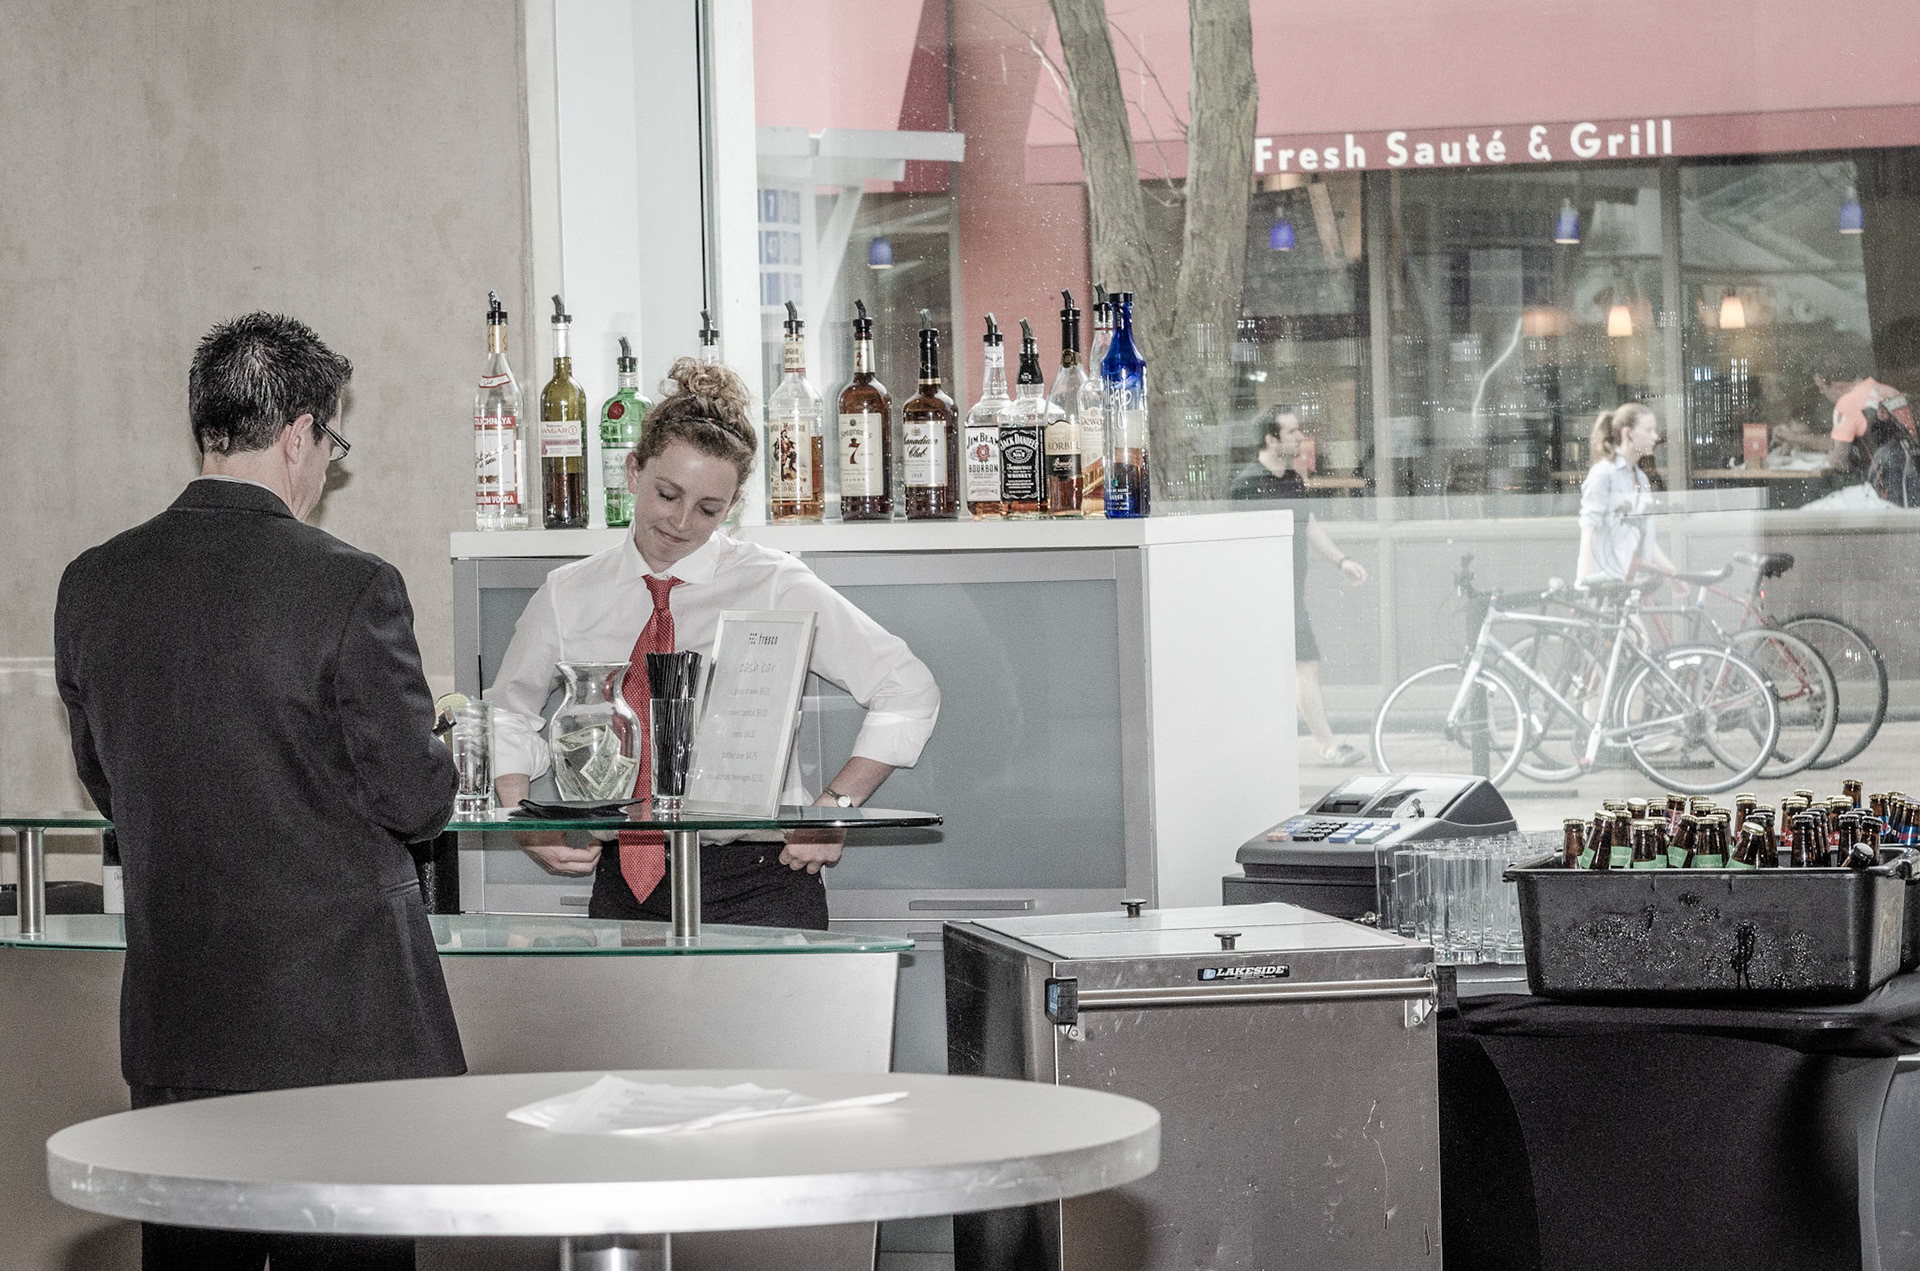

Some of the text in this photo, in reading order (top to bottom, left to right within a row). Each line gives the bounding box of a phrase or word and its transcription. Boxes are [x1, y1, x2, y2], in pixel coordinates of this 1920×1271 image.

[1254, 119, 1672, 173] Fresh Sauté & Grill
[967, 435, 979, 449] JIM
[1000, 436, 1015, 451] JACK
[848, 442, 861, 464] 7
[968, 464, 999, 473] BOURBON
[1216, 965, 1285, 977] LAKESIDE
